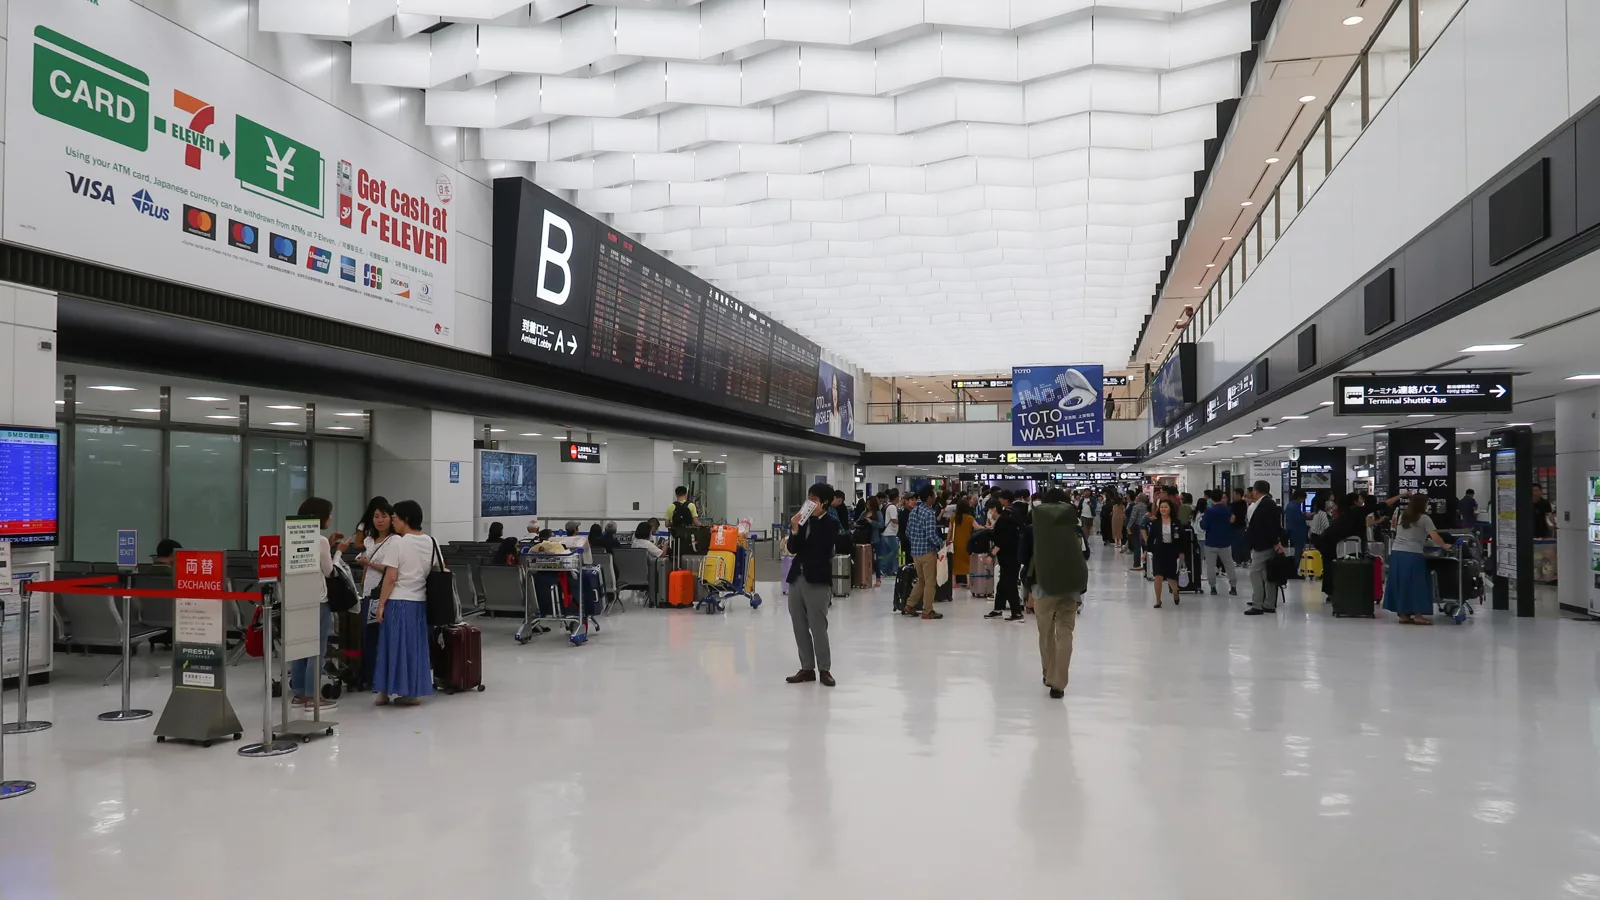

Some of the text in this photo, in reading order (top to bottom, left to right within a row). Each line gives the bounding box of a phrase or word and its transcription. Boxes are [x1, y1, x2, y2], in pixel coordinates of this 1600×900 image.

[50, 69, 136, 124] CARD
[65, 170, 116, 205] VISA
[65, 146, 90, 164] Using
[92, 157, 111, 169] your
[112, 162, 131, 176] ATM
[153, 176, 189, 195] Japanese
[189, 190, 219, 207] currency
[220, 200, 233, 211] can
[234, 204, 242, 214] be
[243, 208, 275, 225] withdrawn
[276, 217, 290, 230] from
[291, 223, 306, 235] ATMs
[307, 230, 313, 238] at
[357, 168, 448, 234] Get cash at
[141, 201, 170, 221] PLUS
[536, 208, 574, 306] B
[364, 271, 382, 283] JCB
[390, 277, 409, 289] DISCOVER
[521, 318, 555, 338] 到着ロビー
[520, 333, 552, 351] Arrival Lobby
[554, 329, 564, 354] A
[1367, 385, 1438, 395] ターミナル連絡バス
[1368, 396, 1447, 405] Terminal Shuttle Bus
[1018, 409, 1062, 427] TOTO
[1054, 453, 1063, 462] A
[119, 536, 135, 546] 出口
[119, 548, 135, 556] EXIT
[260, 545, 279, 558] 入口
[186, 559, 214, 575] 両替
[177, 579, 221, 591] EXCHANGE
